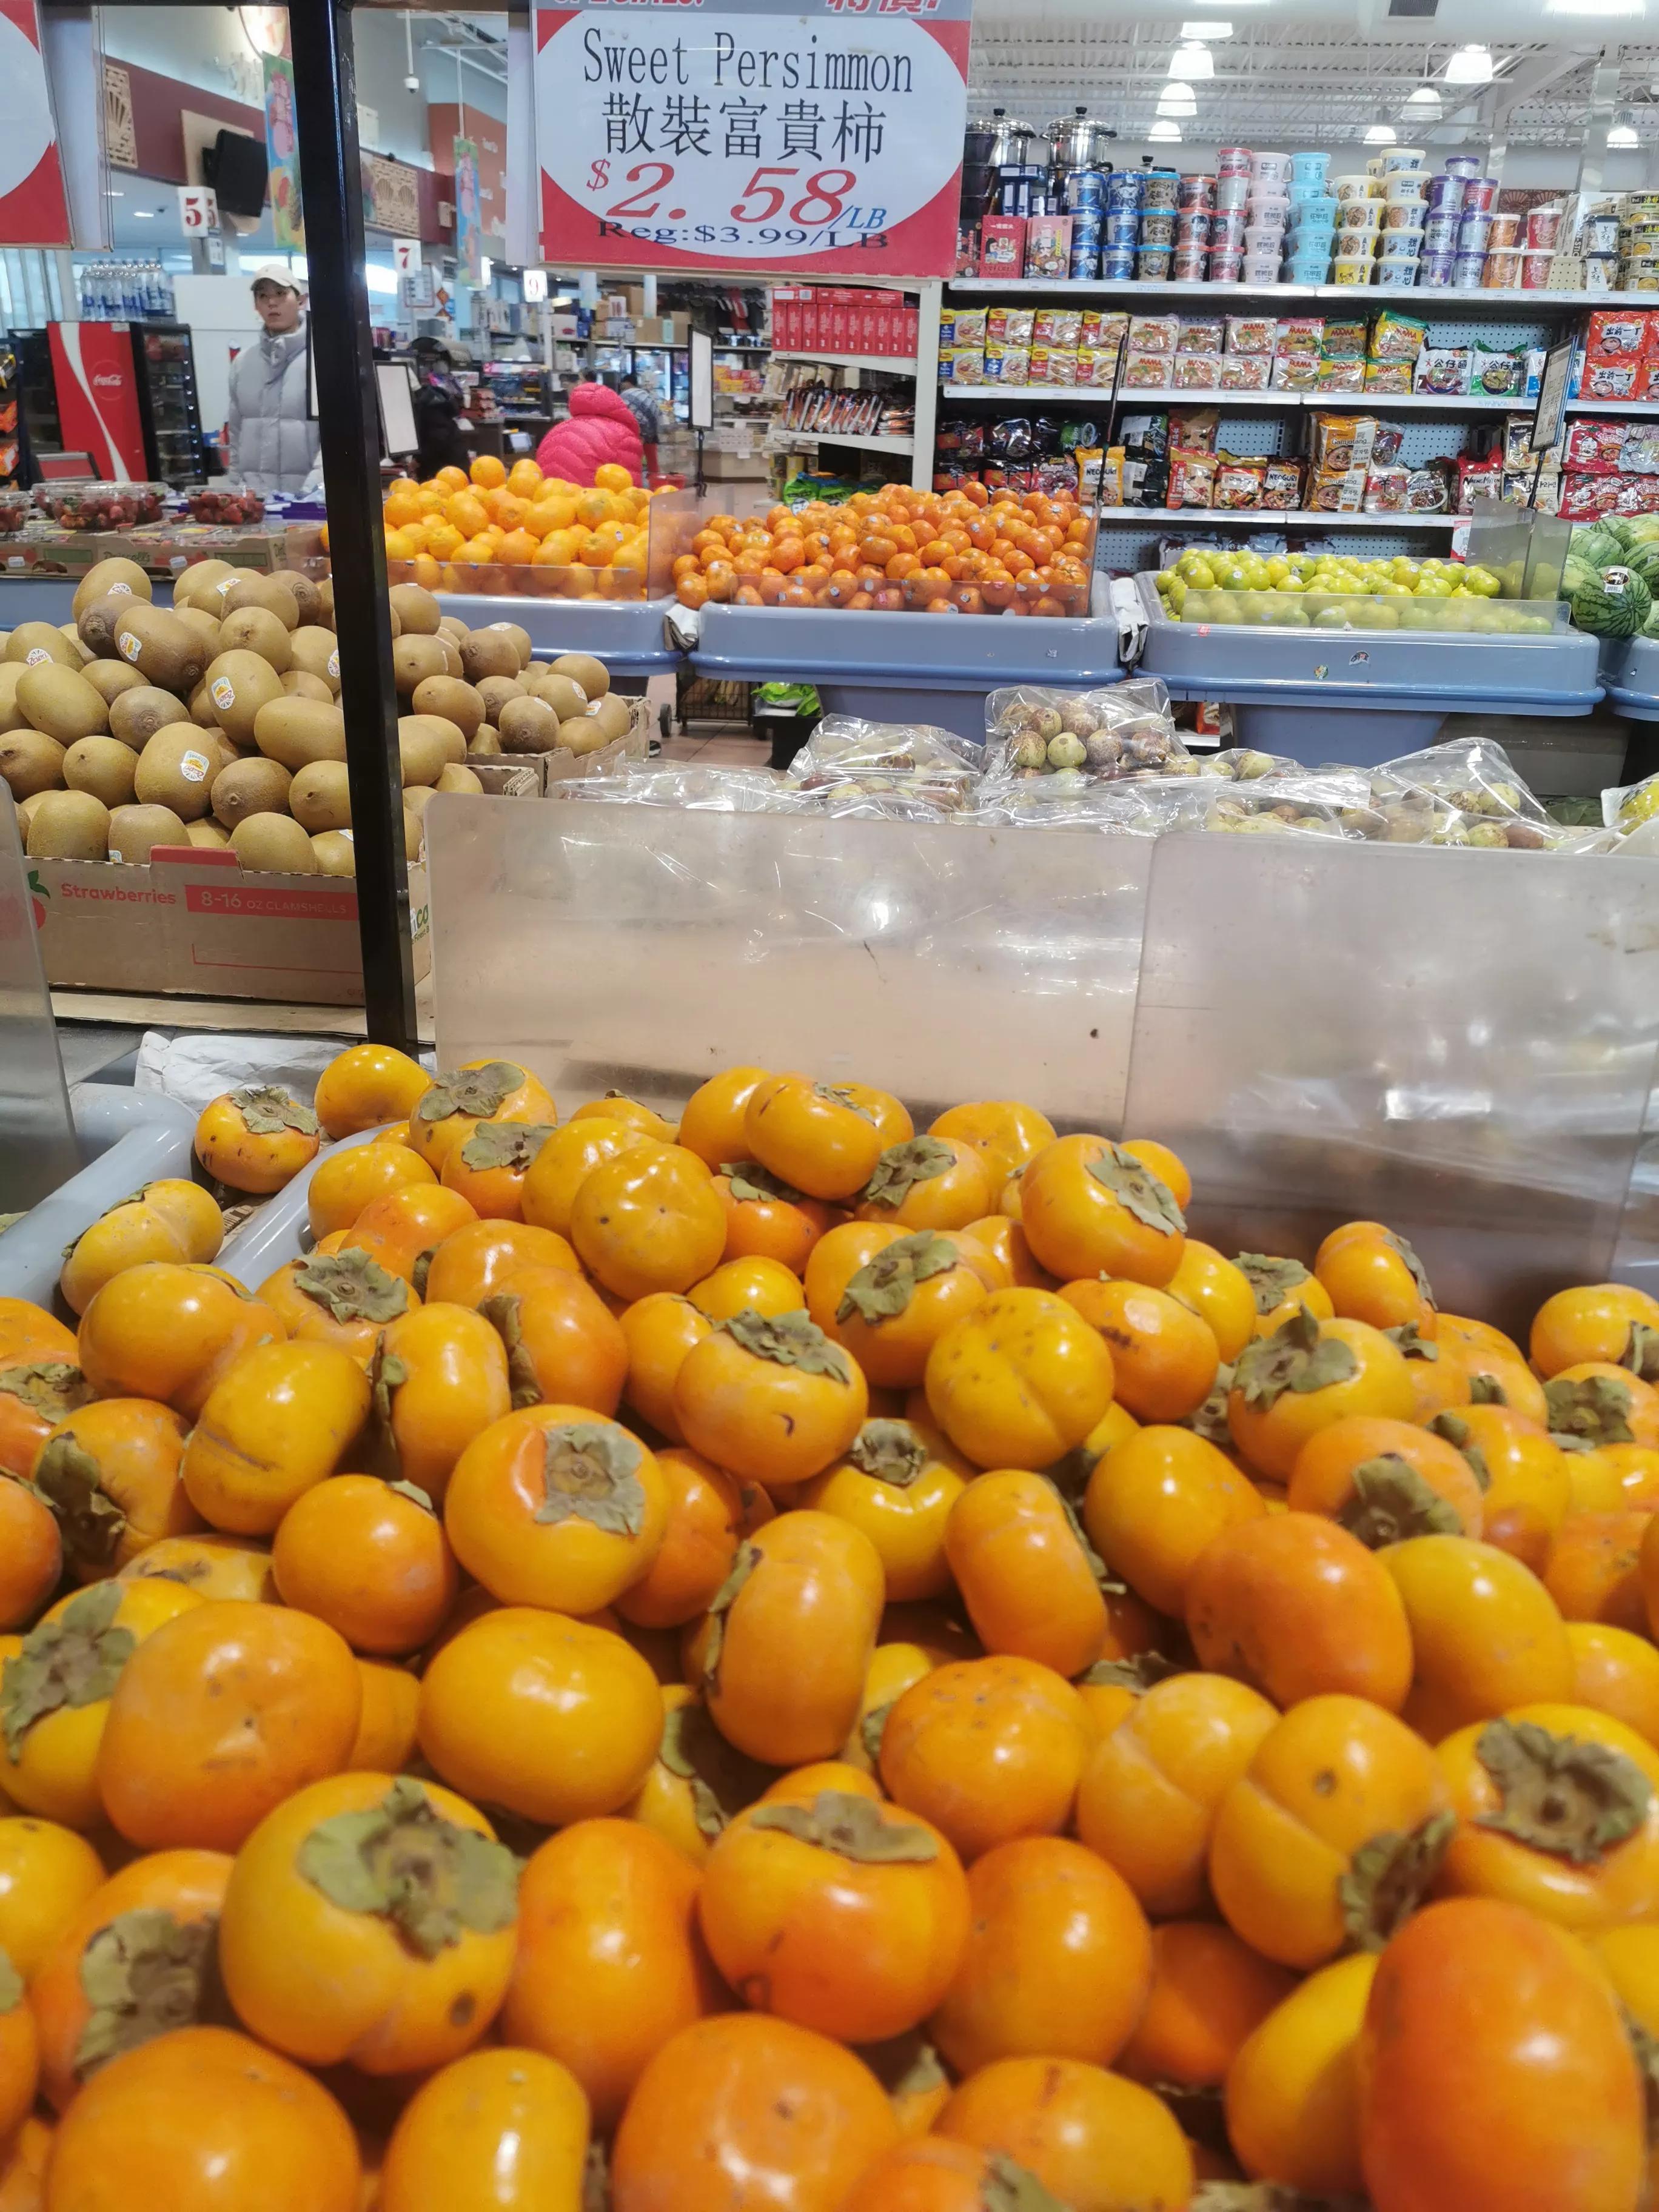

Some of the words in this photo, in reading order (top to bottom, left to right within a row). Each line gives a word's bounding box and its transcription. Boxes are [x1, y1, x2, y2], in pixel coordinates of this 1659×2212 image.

[583, 28, 689, 84] Sweet
[714, 32, 913, 93] Persimmon
[602, 92, 887, 164] 散裝富貴柿
[186, 198, 202, 226] 5
[398, 247, 411, 269] 7
[529, 278, 538, 295] 9
[1289, 326, 1312, 335] MAMA
[61, 883, 176, 905] Strawberries
[201, 891, 241, 908] 8-16
[247, 900, 263, 910] OZ
